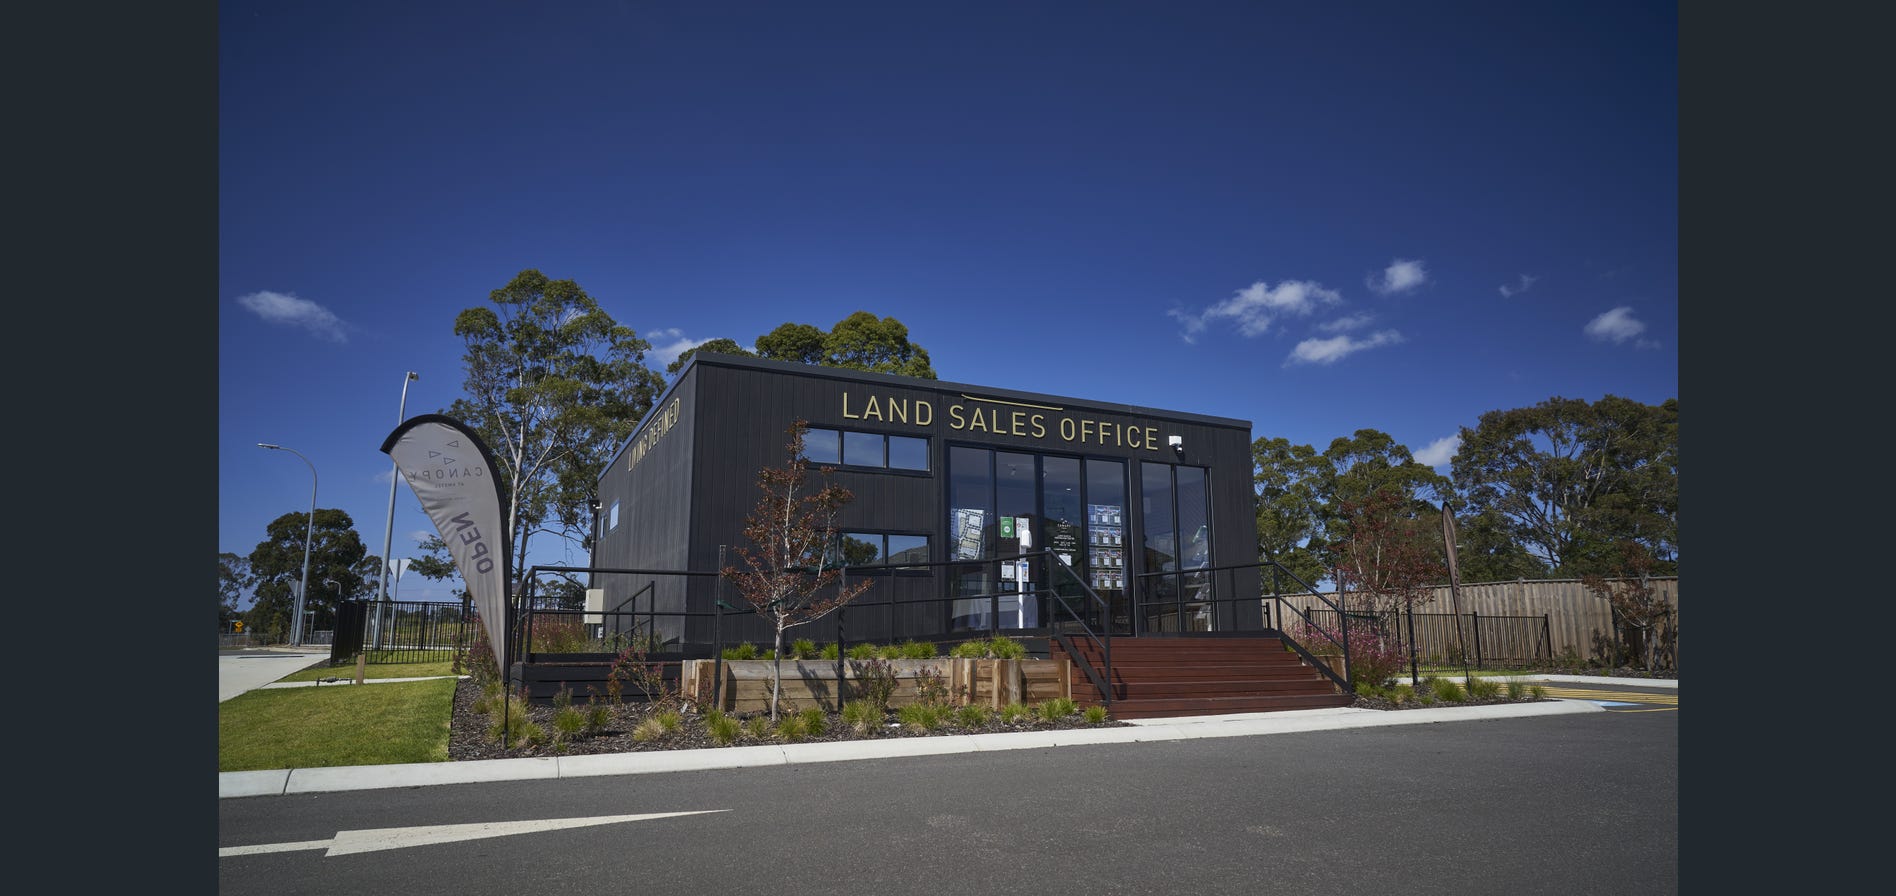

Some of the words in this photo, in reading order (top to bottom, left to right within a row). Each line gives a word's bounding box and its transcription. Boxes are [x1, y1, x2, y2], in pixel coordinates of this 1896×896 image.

[628, 434, 648, 472] LIVING
[649, 398, 680, 450] DEFINED
[843, 392, 932, 426] LAND
[950, 405, 1046, 438] SALES
[1060, 418, 1158, 450] OFFICE
